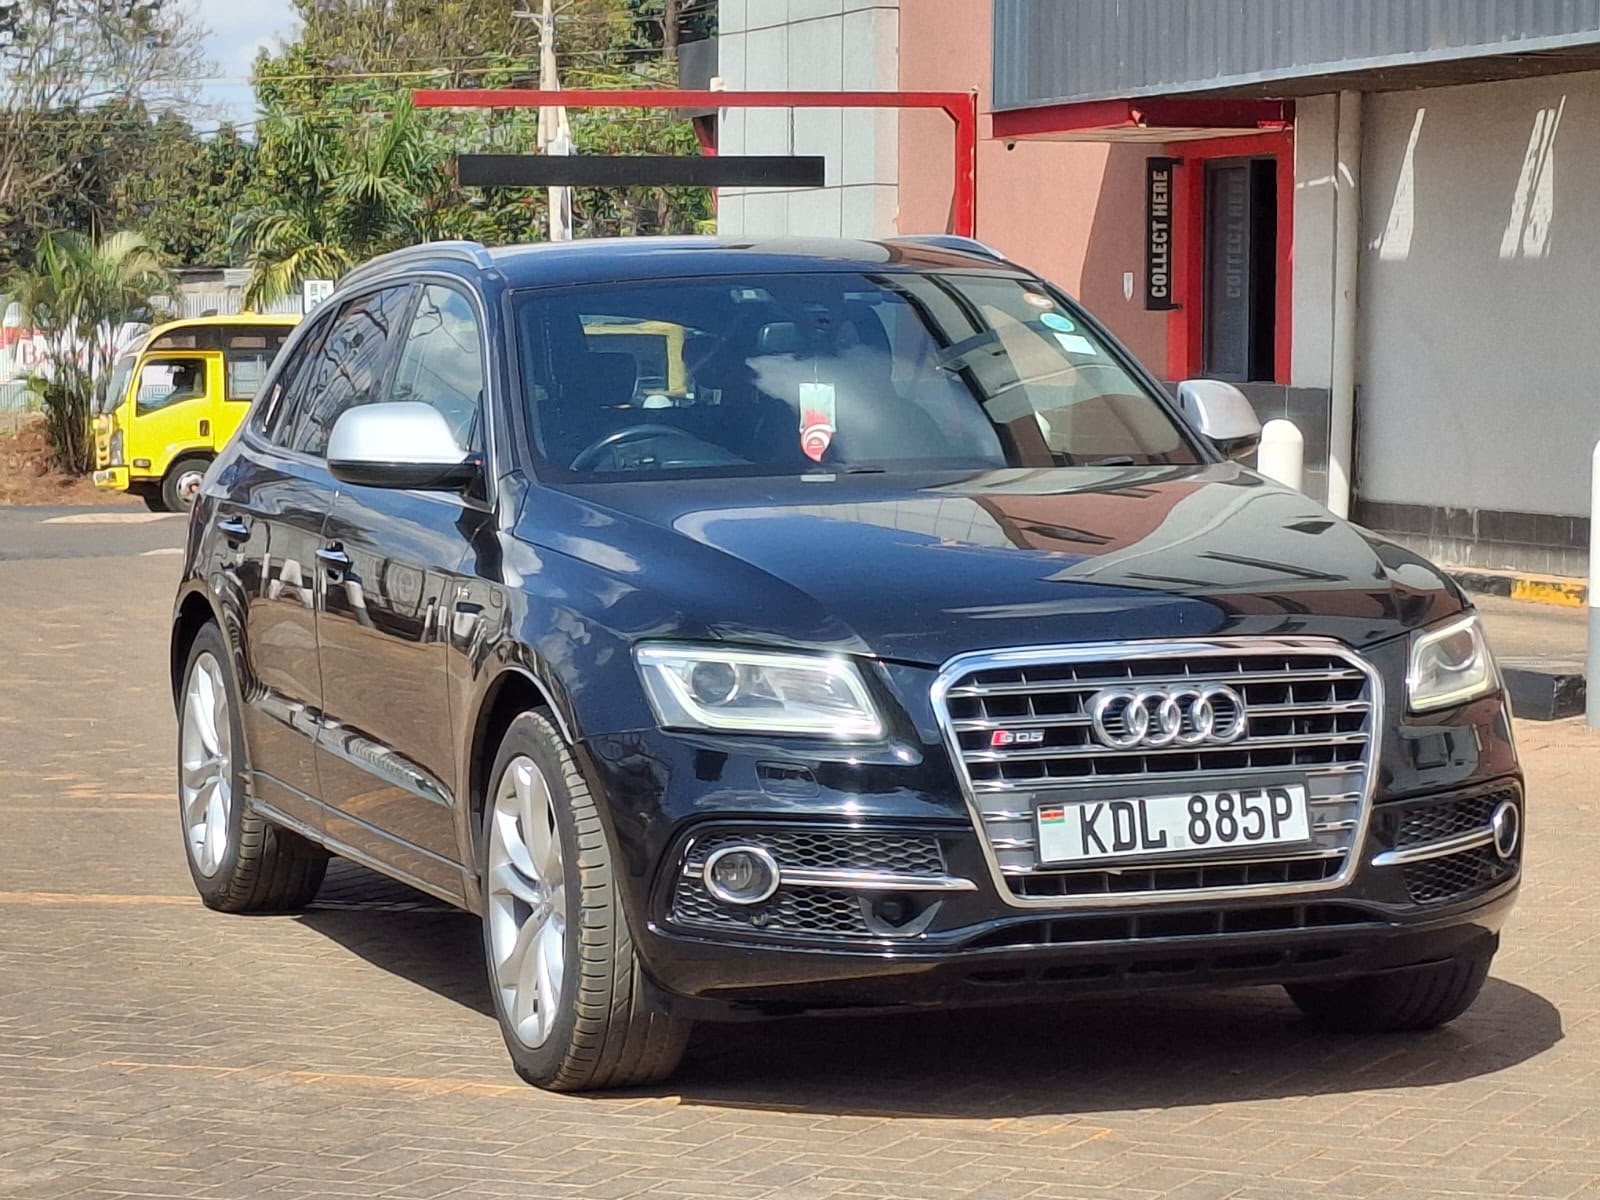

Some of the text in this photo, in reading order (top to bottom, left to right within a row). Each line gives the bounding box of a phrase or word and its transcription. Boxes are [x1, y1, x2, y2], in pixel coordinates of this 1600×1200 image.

[1151, 170, 1168, 298] COLLECT HERE
[1080, 788, 1292, 855] KDL 885P
